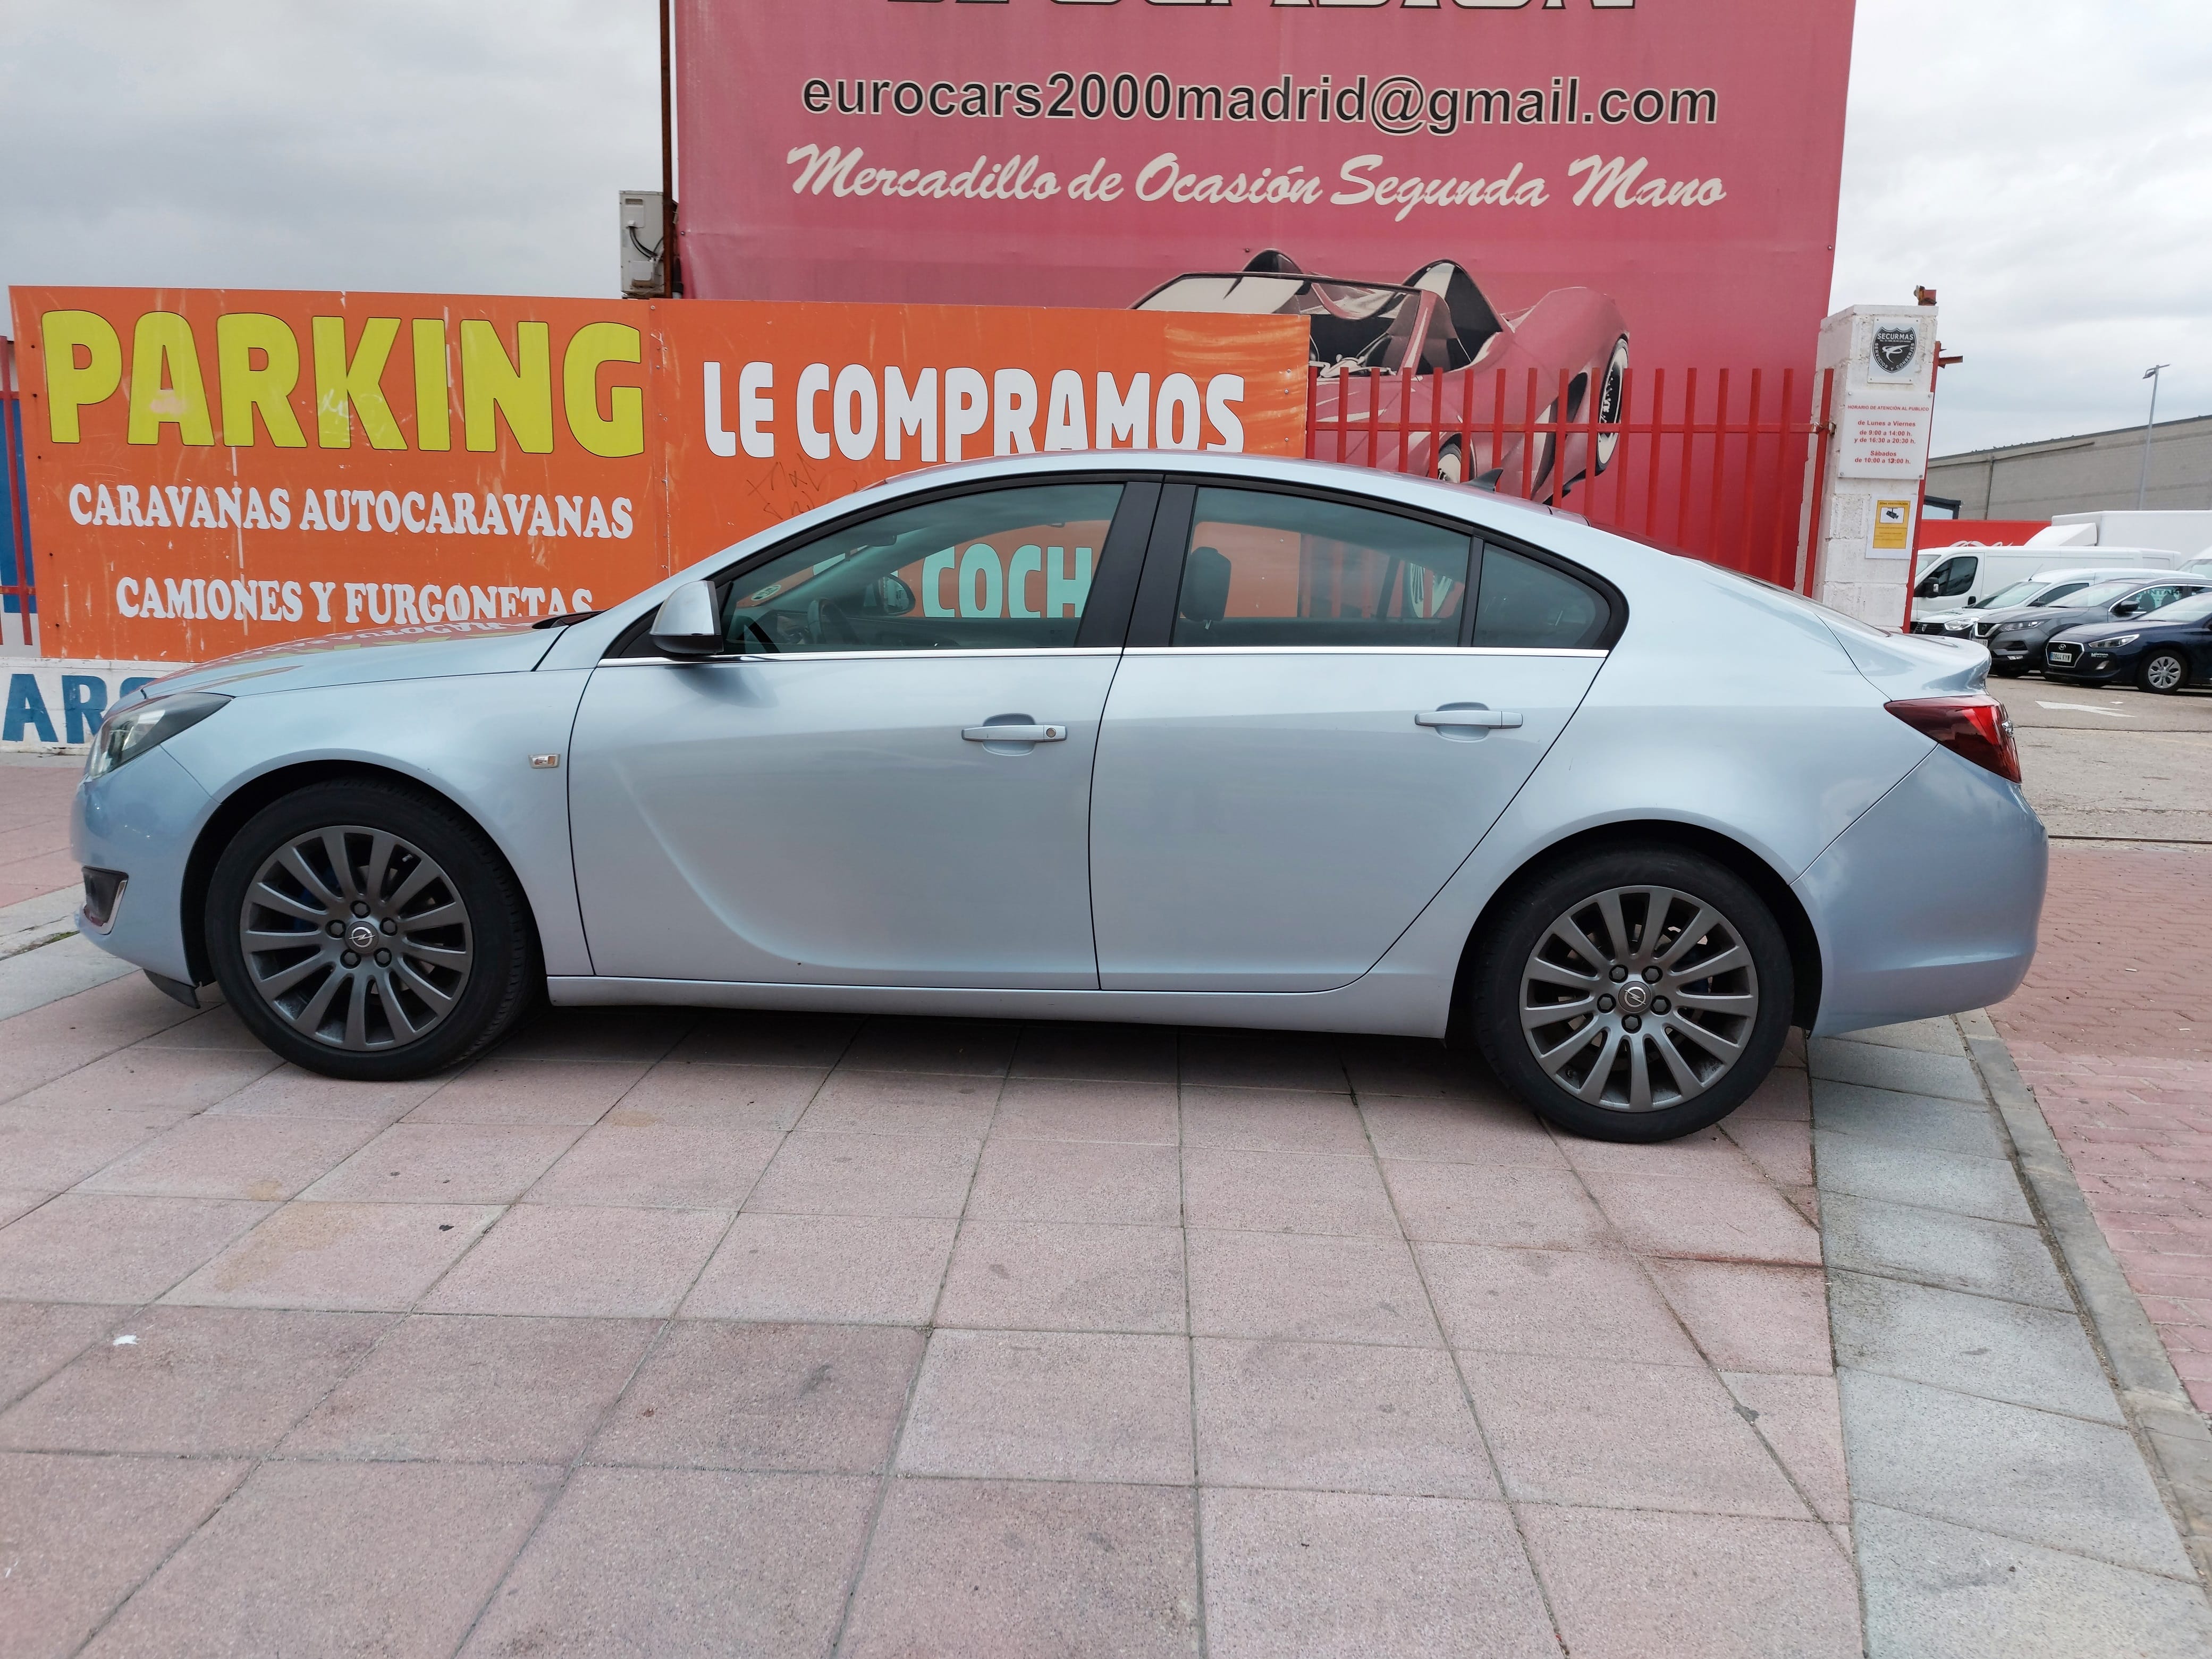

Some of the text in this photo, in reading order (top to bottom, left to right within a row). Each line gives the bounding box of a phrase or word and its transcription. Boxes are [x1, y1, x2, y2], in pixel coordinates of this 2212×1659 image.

[803, 72, 1717, 136] eurocars2000madrid@gmail.com
[787, 143, 1727, 222] Mercadillo de Ocasión Segunda Mano
[41, 310, 644, 458] PARKING
[703, 361, 1245, 462] LE COMPRAMOS
[69, 483, 633, 539] CARAVANAS AUTOCARAVANAS
[116, 577, 593, 625] CAMIONES Y FURGONETAS
[3, 674, 158, 744] AR
